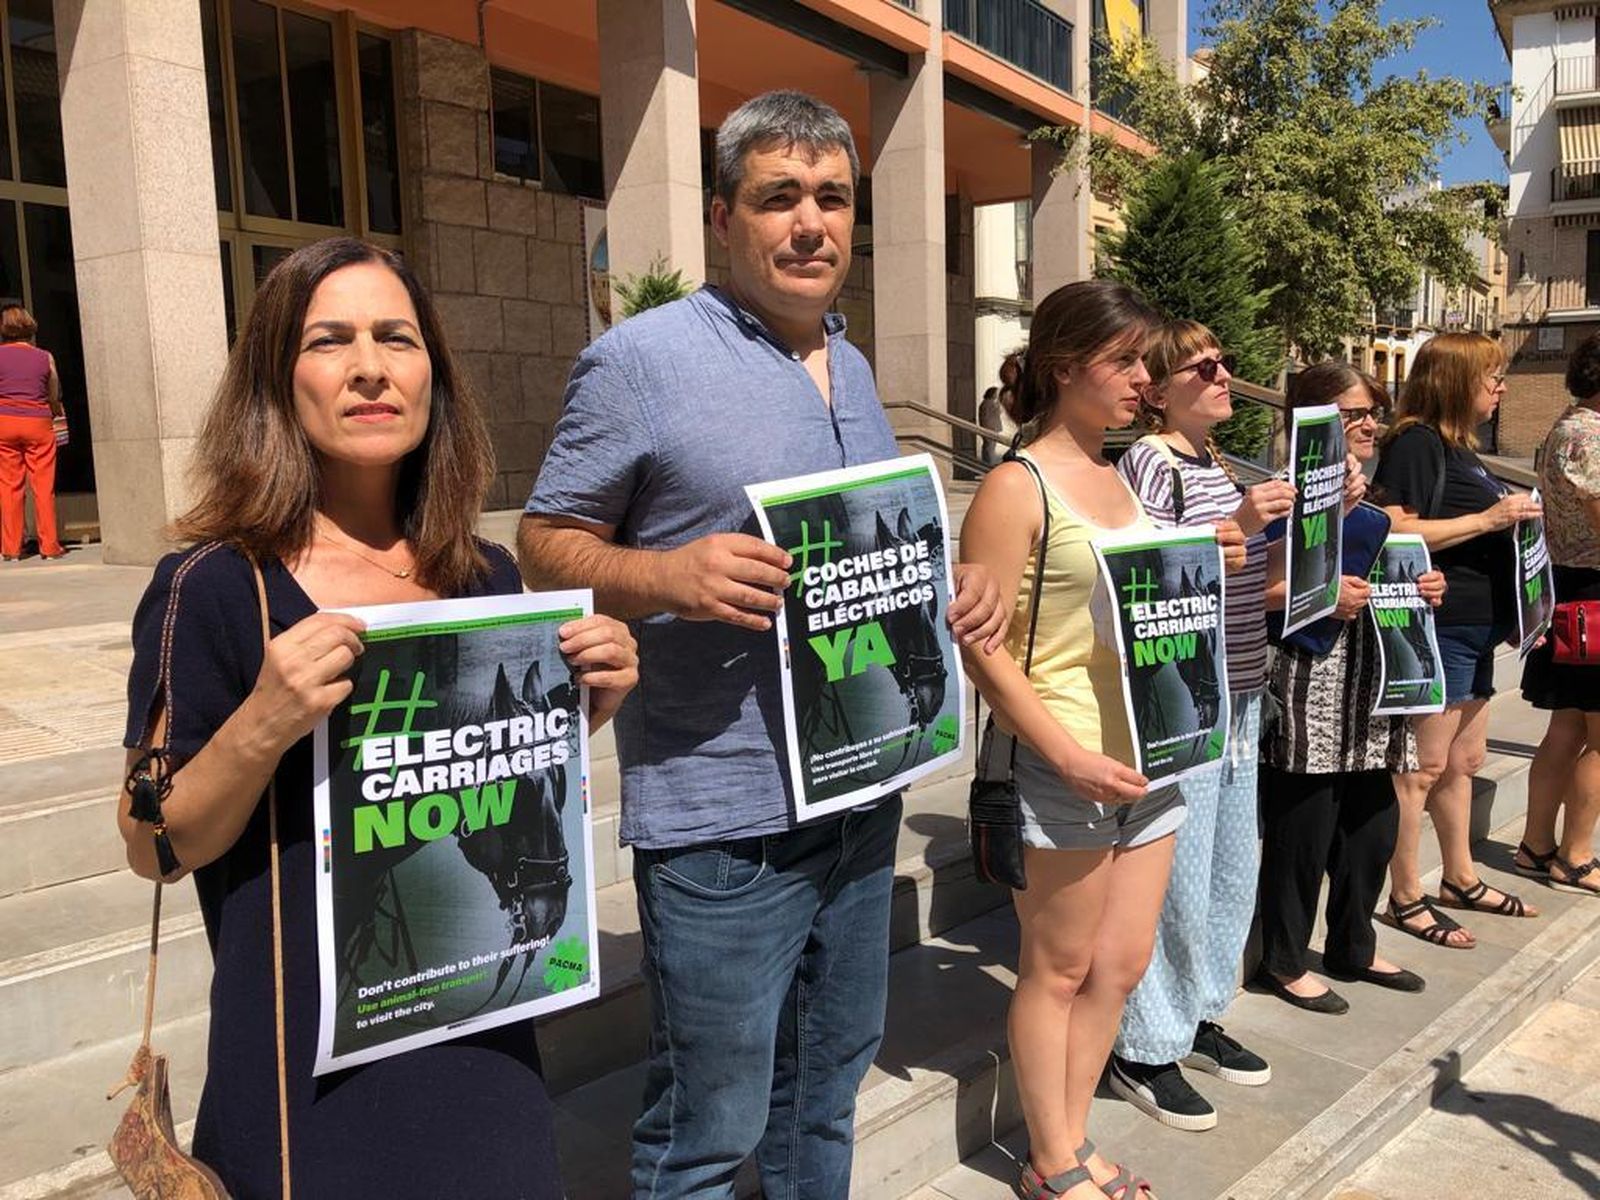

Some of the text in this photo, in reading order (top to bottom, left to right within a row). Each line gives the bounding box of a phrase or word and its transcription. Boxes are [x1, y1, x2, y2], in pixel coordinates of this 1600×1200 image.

[1305, 464, 1337, 483] COCHES
[1302, 512, 1327, 549] YA
[803, 540, 929, 586] COCHES DE
[805, 561, 933, 608] CABALLOS
[1370, 582, 1419, 597] ELECTRI
[808, 584, 934, 632] ELÉCTRICOS
[1131, 594, 1218, 622] ELECTRIC
[1375, 608, 1410, 628] NOW
[1134, 614, 1218, 640] CARRIAGES
[808, 621, 896, 682] YA
[1133, 632, 1198, 668] NOW
[362, 708, 569, 770] ELECTRIC
[361, 740, 570, 801] CARRIAGES
[354, 780, 518, 854] NOW
[358, 935, 550, 999] Don't contribute to their suffering!
[548, 957, 583, 972] PACMA
[356, 1001, 436, 1030] to visit the city.
[357, 1003, 379, 1014] Use
[380, 985, 440, 1008] animal-free
